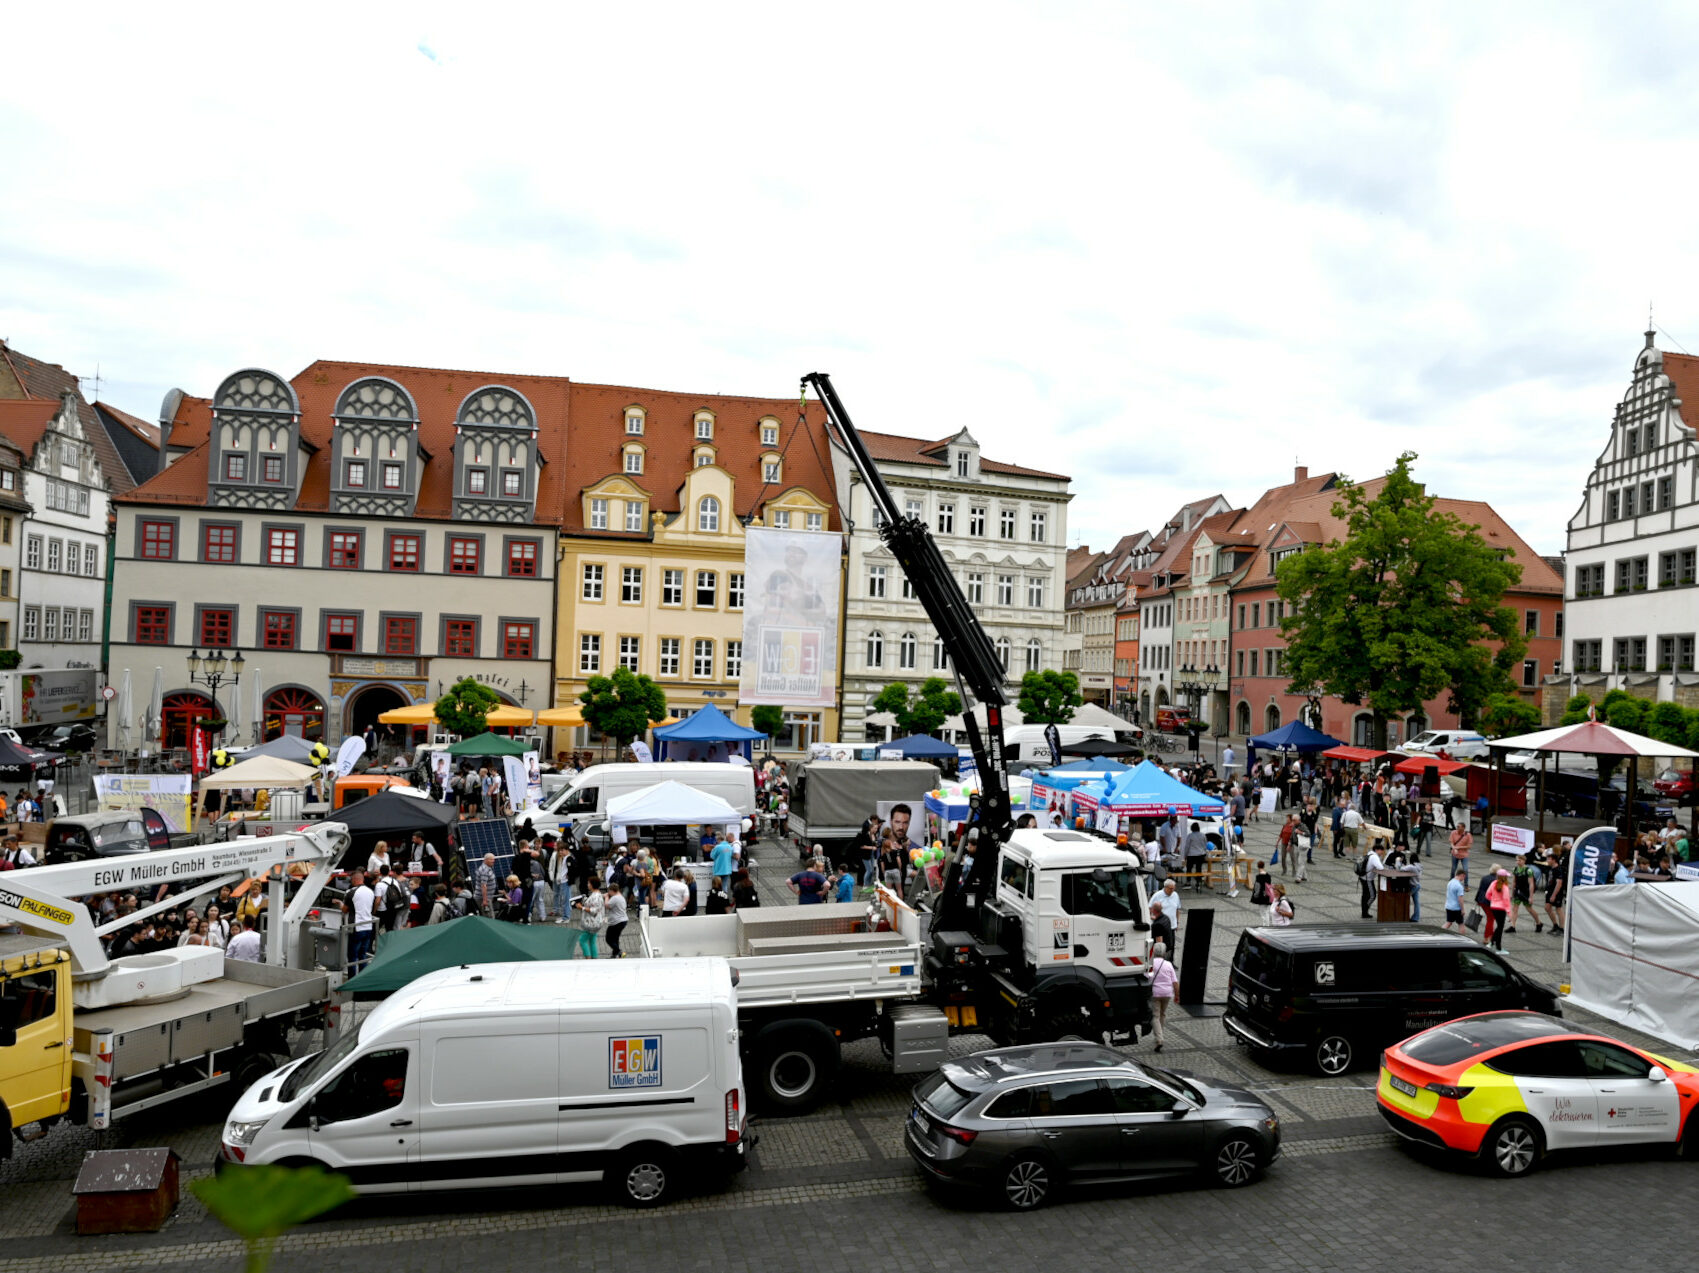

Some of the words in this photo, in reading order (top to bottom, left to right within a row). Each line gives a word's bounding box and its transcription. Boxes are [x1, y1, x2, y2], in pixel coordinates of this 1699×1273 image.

[195, 728, 204, 768] HILTI
[94, 869, 124, 886] EGW
[131, 864, 168, 881] Müller
[172, 857, 205, 875] GmbH
[22, 900, 72, 923] PALFINGER
[1316, 963, 1335, 984] es
[613, 1048, 657, 1073] EGW
[612, 1073, 635, 1086] Müller
[637, 1073, 658, 1085] GmbH
